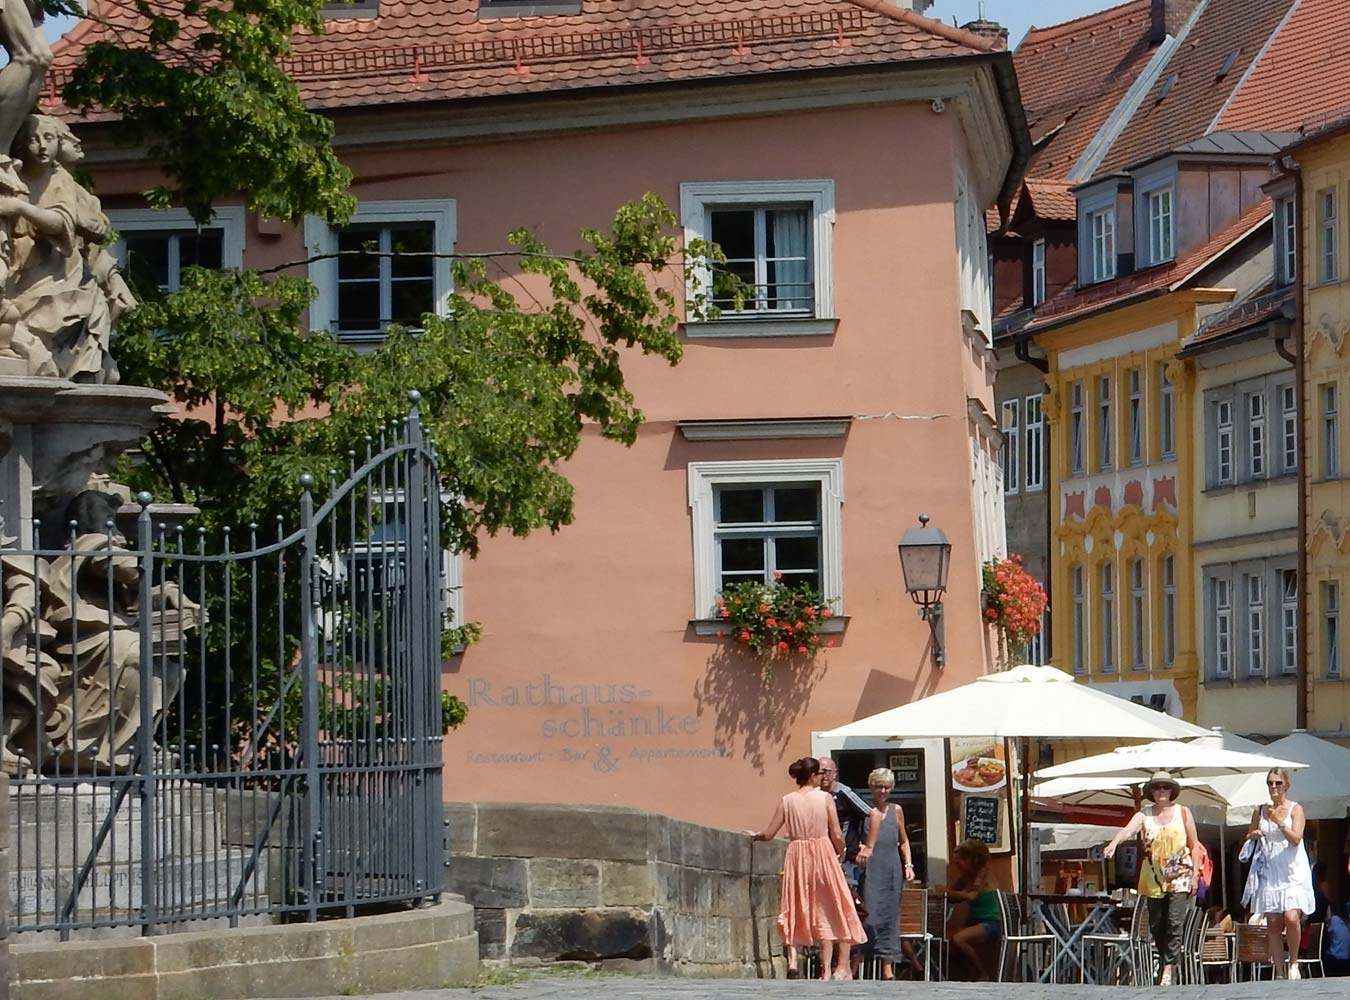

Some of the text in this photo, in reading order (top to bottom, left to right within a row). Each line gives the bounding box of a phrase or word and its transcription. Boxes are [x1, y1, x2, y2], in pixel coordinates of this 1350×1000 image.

[467, 673, 652, 707] Rathaus-
[541, 704, 701, 738] schänke
[593, 744, 621, 774] &
